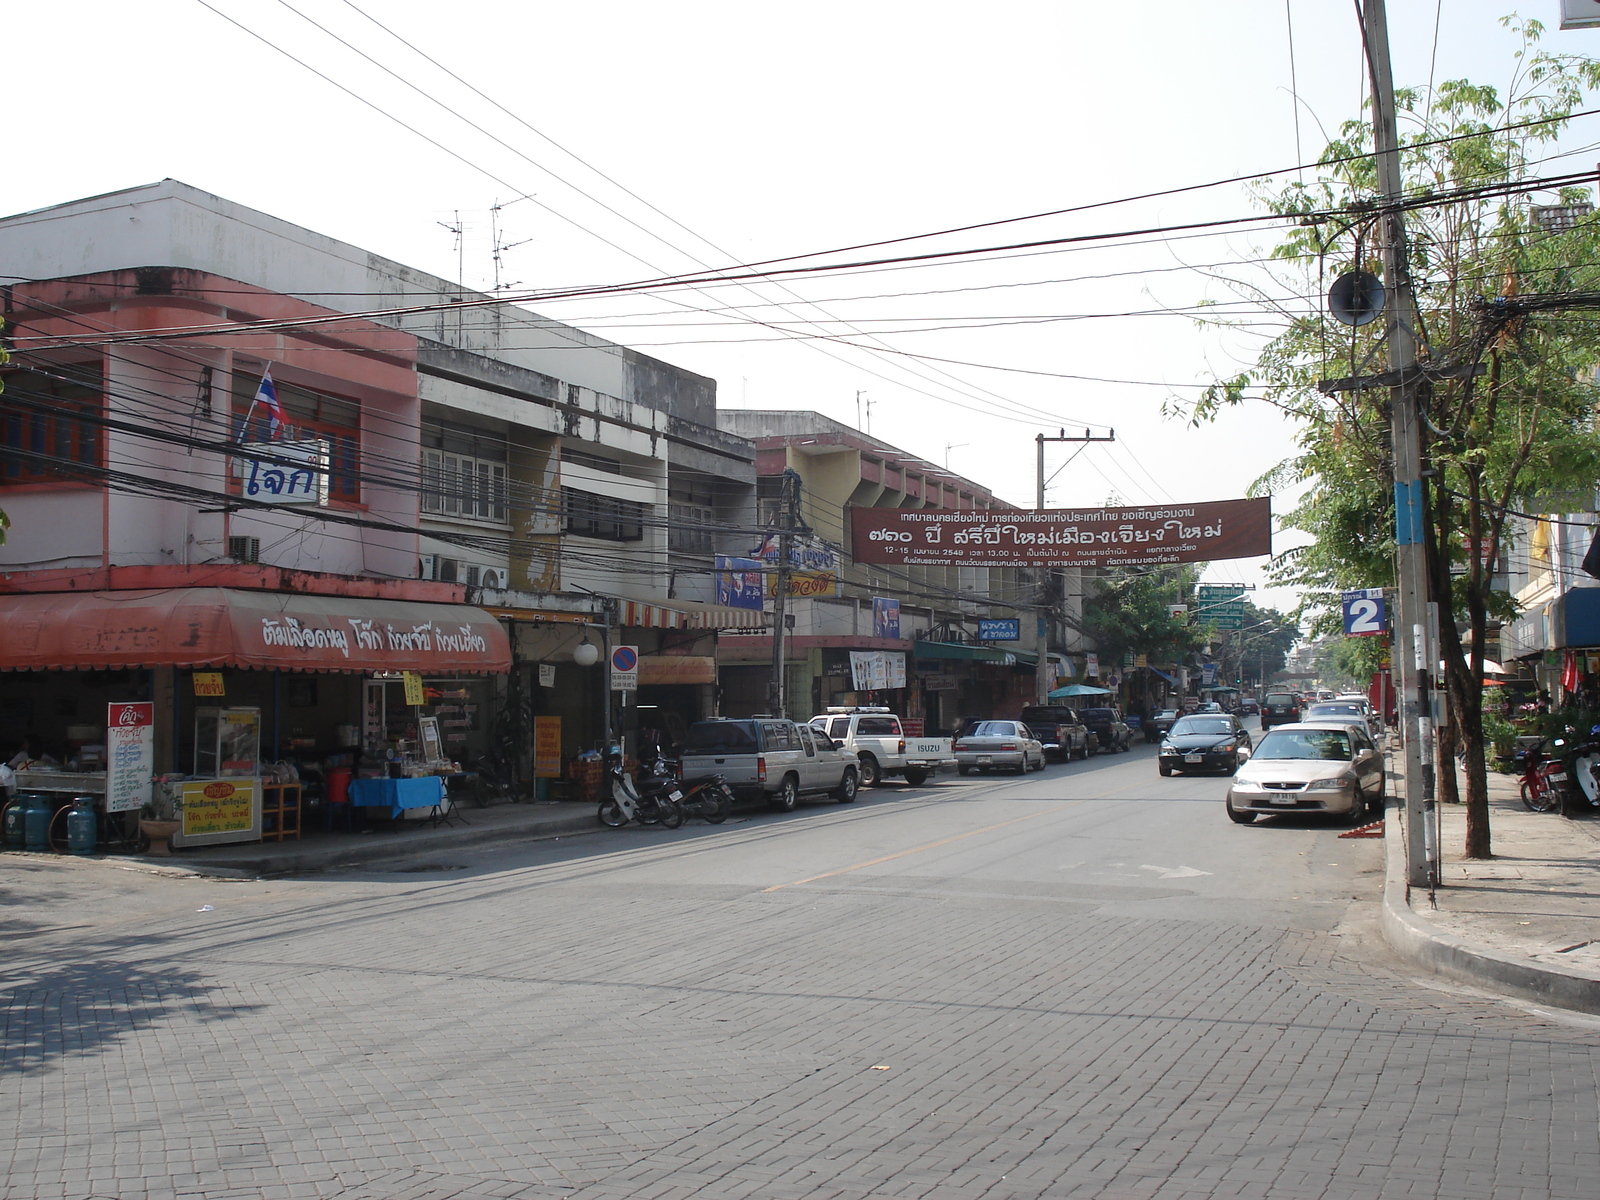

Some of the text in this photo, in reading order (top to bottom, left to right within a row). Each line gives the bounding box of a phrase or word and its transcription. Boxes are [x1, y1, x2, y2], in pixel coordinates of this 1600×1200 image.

[900, 507, 1195, 523] เทศบาลนครเชียงใหม่ การท่องเที่ยวแห่งประเทศไทย ขอเชิญร่วมงาน
[913, 548, 940, 556] เมษายน
[987, 549, 1008, 557] 13.00
[1026, 548, 1059, 557] เป็นต้นไป
[1076, 547, 1128, 556] ถนนราชดำเนิน
[1349, 599, 1380, 633] 2
[261, 616, 349, 658] ต้มเลือดหมู
[348, 618, 384, 650] โจ๊ก
[917, 744, 940, 753] ISUZU
